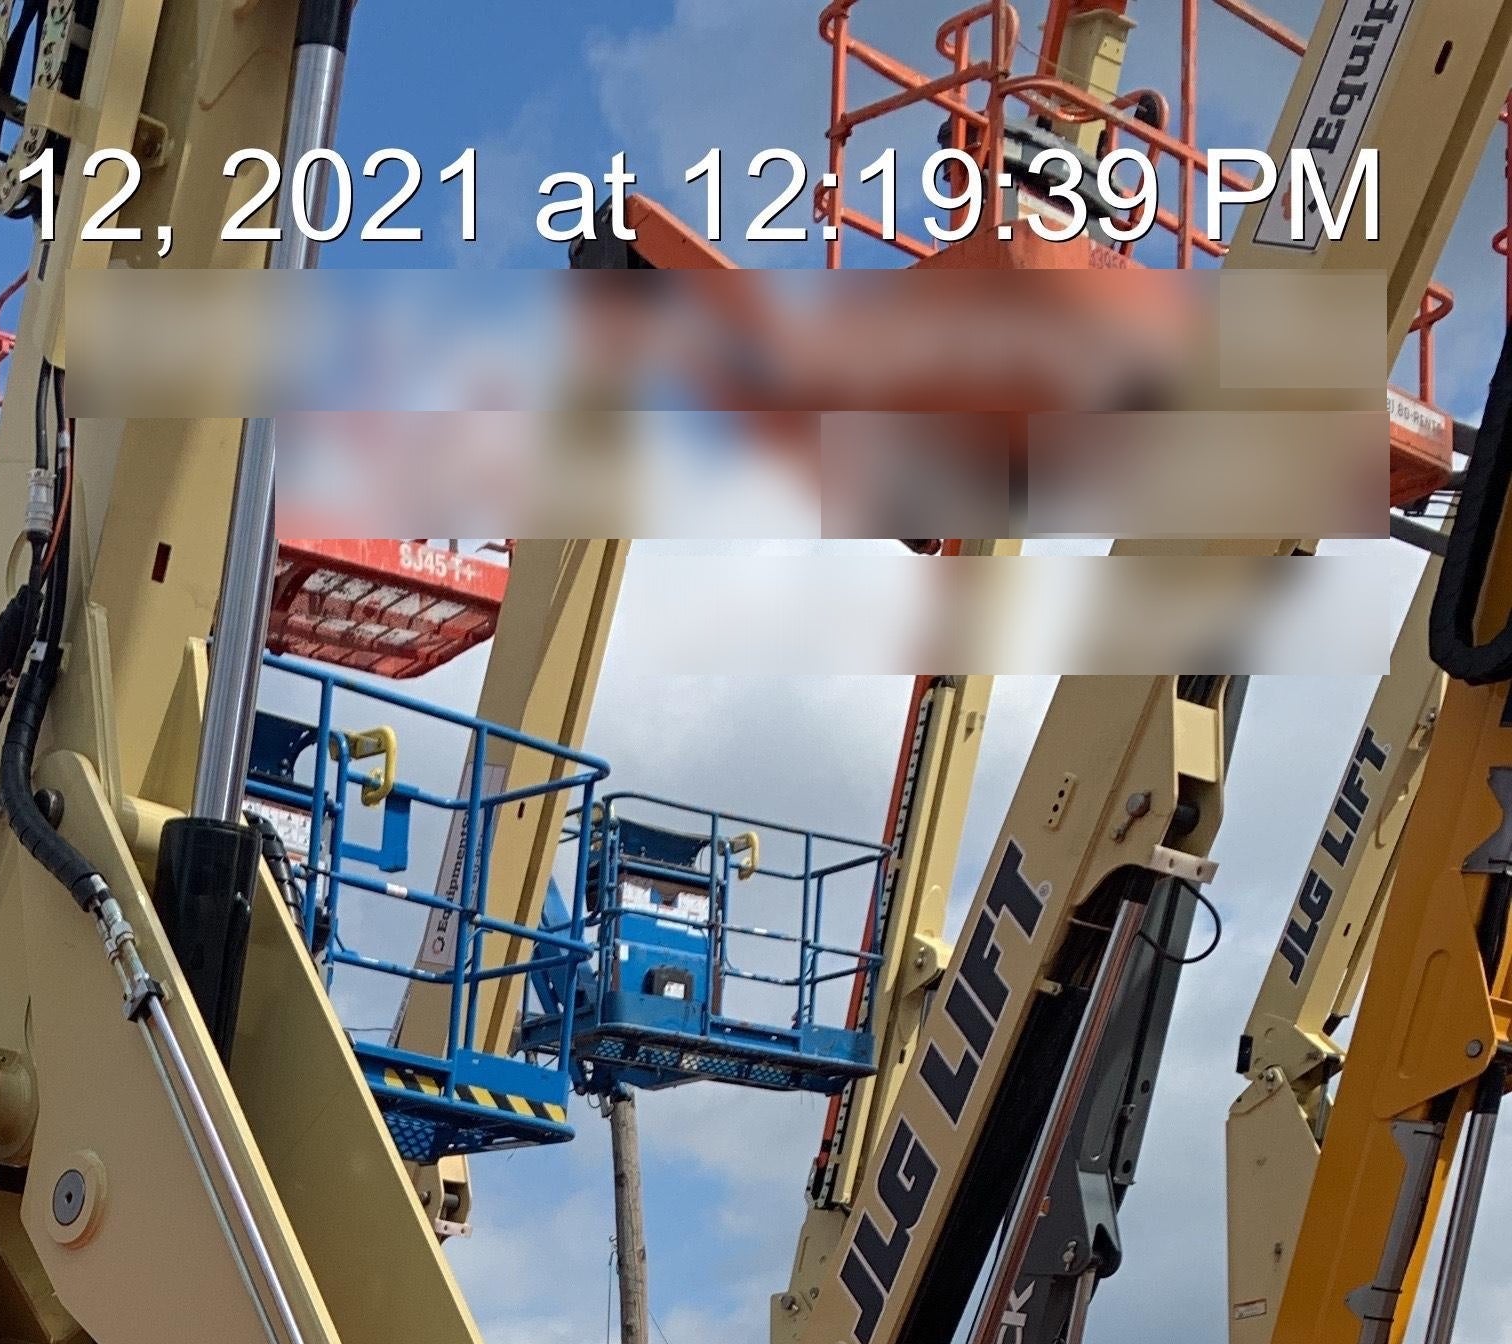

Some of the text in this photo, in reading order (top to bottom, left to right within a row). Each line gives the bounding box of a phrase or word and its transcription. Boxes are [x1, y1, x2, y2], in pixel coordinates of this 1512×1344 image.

[918, 839, 1048, 1131] LIFT
[1276, 726, 1390, 988] JLG LIFT
